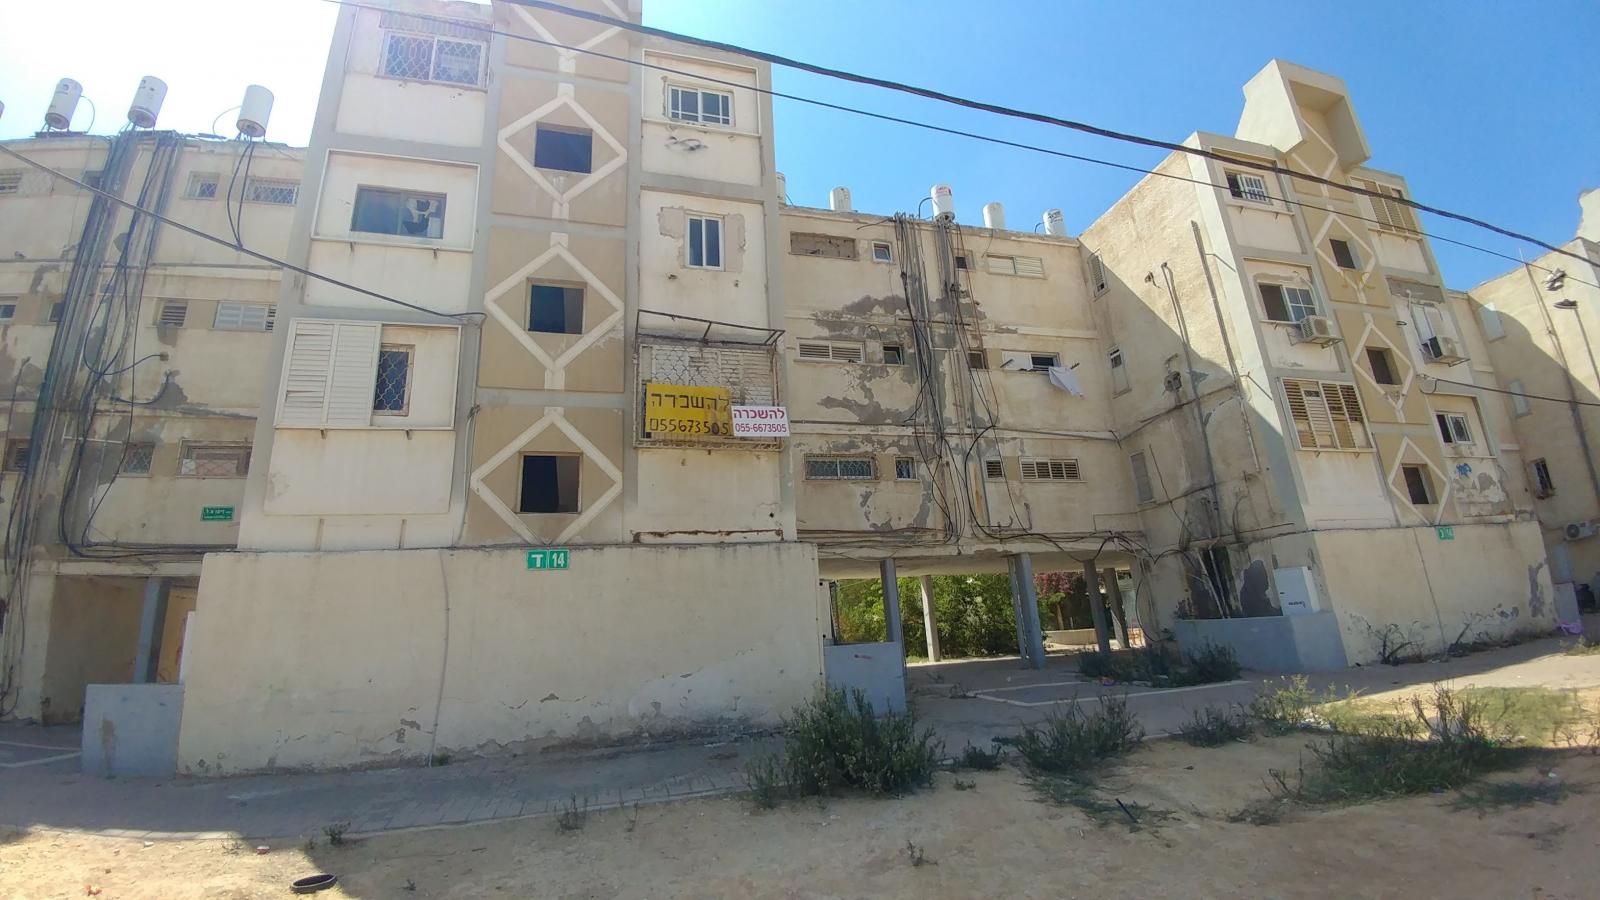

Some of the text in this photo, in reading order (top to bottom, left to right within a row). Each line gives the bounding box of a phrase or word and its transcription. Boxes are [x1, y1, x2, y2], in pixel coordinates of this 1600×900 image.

[733, 408, 785, 419] להשכרה
[735, 423, 787, 433] 055-6673505
[552, 552, 566, 568] 14
